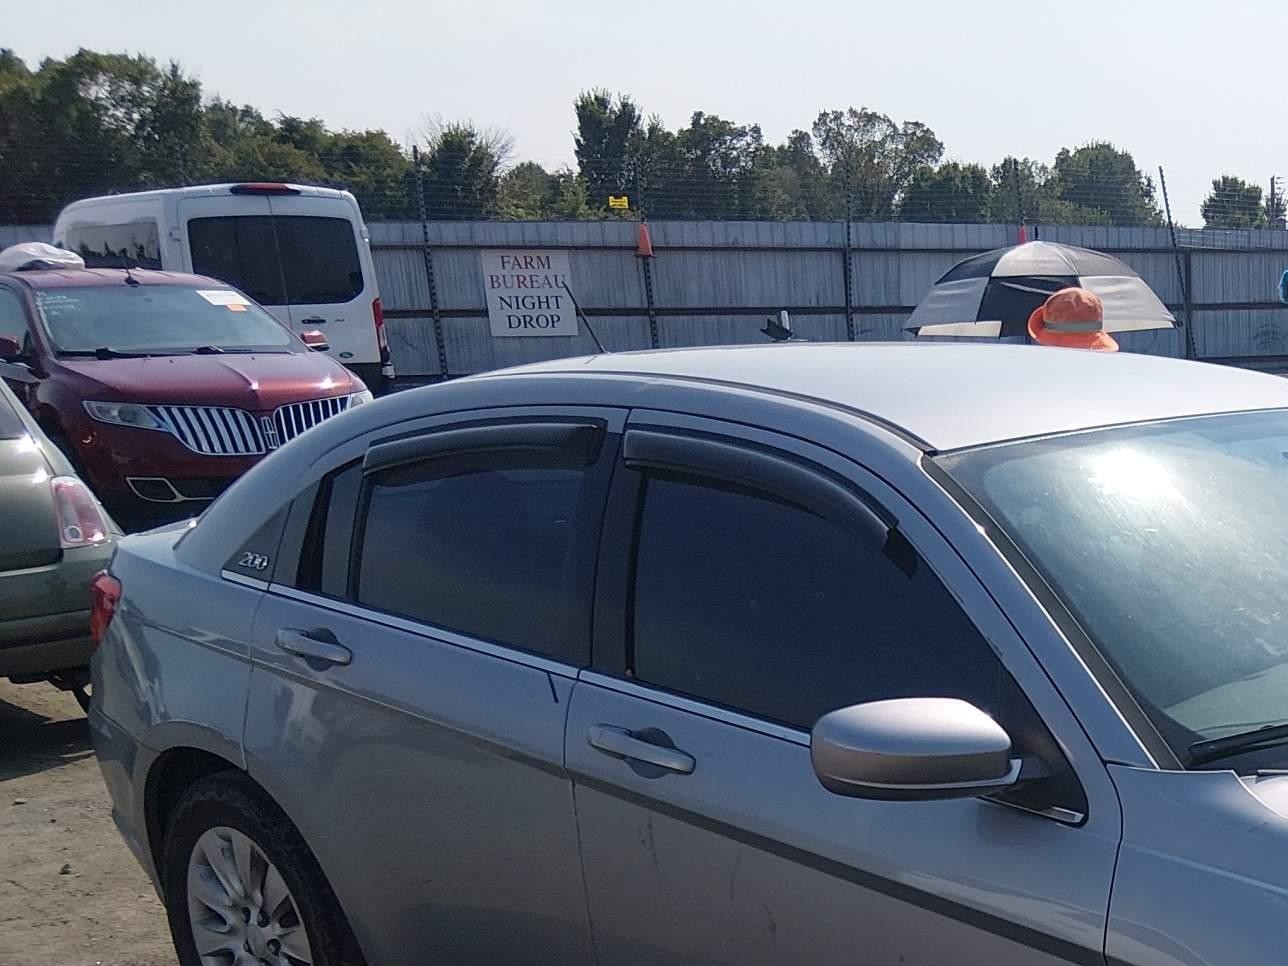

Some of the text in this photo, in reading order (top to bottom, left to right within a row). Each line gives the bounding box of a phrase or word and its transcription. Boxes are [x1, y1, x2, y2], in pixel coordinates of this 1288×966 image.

[500, 255, 551, 270] FARM
[488, 274, 566, 289] BUREAU
[498, 295, 563, 310] NIGHT
[507, 314, 561, 329] DROP
[238, 551, 268, 570] 200
